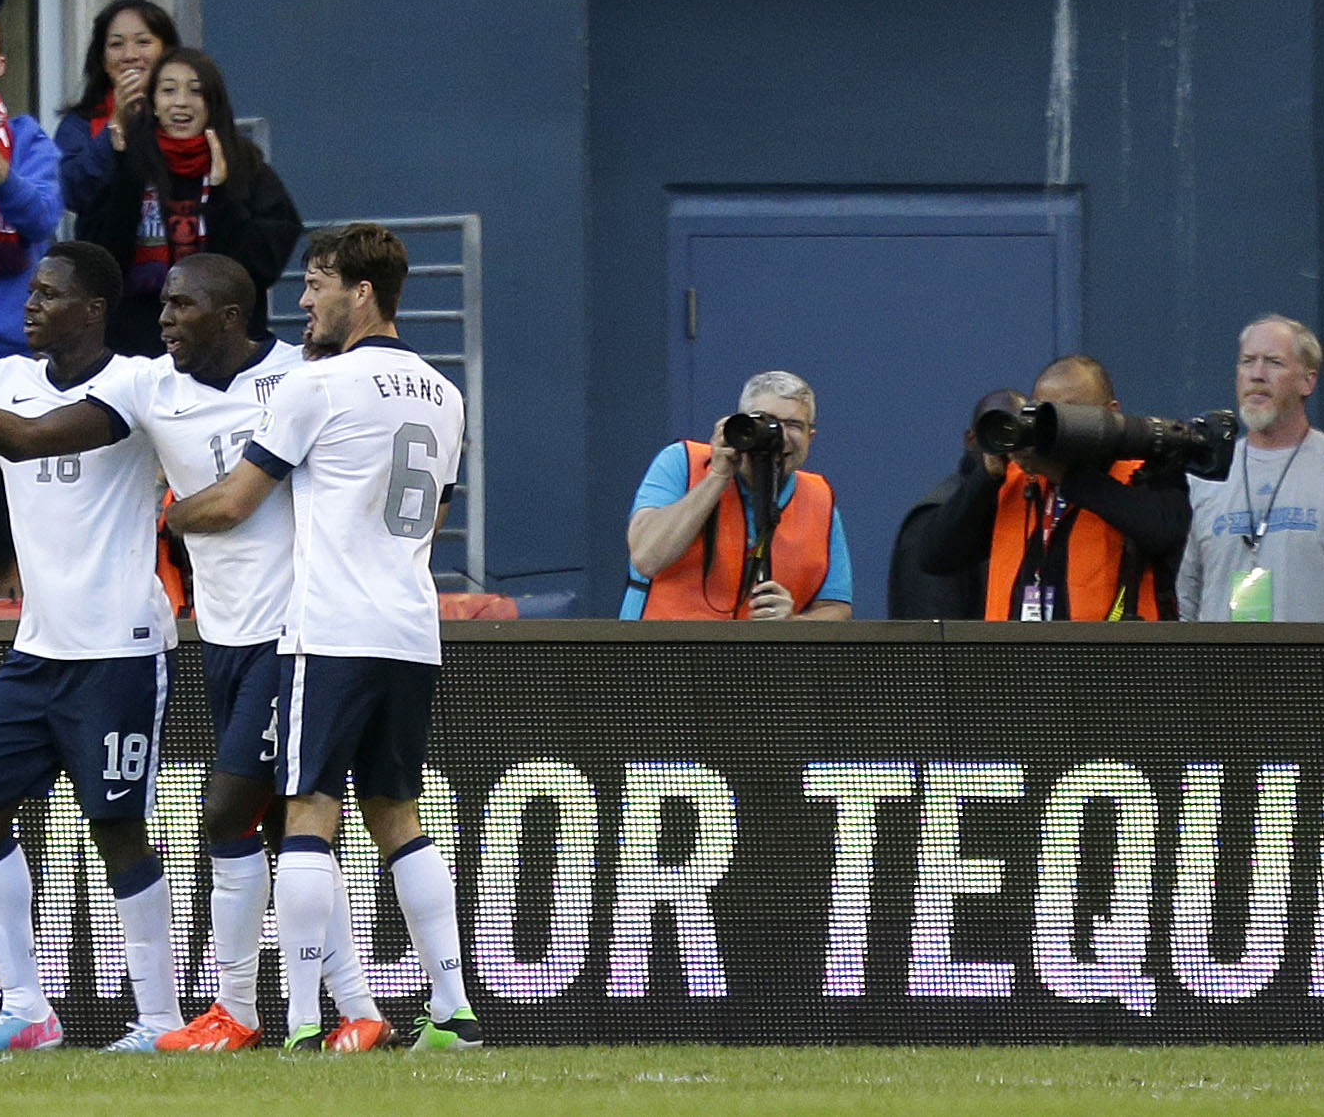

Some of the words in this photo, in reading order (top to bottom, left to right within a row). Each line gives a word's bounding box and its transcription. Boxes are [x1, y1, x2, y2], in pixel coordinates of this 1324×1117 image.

[371, 374, 444, 407] EVANS
[384, 422, 439, 539] 6
[102, 730, 148, 782] 18
[801, 758, 1324, 1018] TEQU
[299, 947, 322, 961] USA
